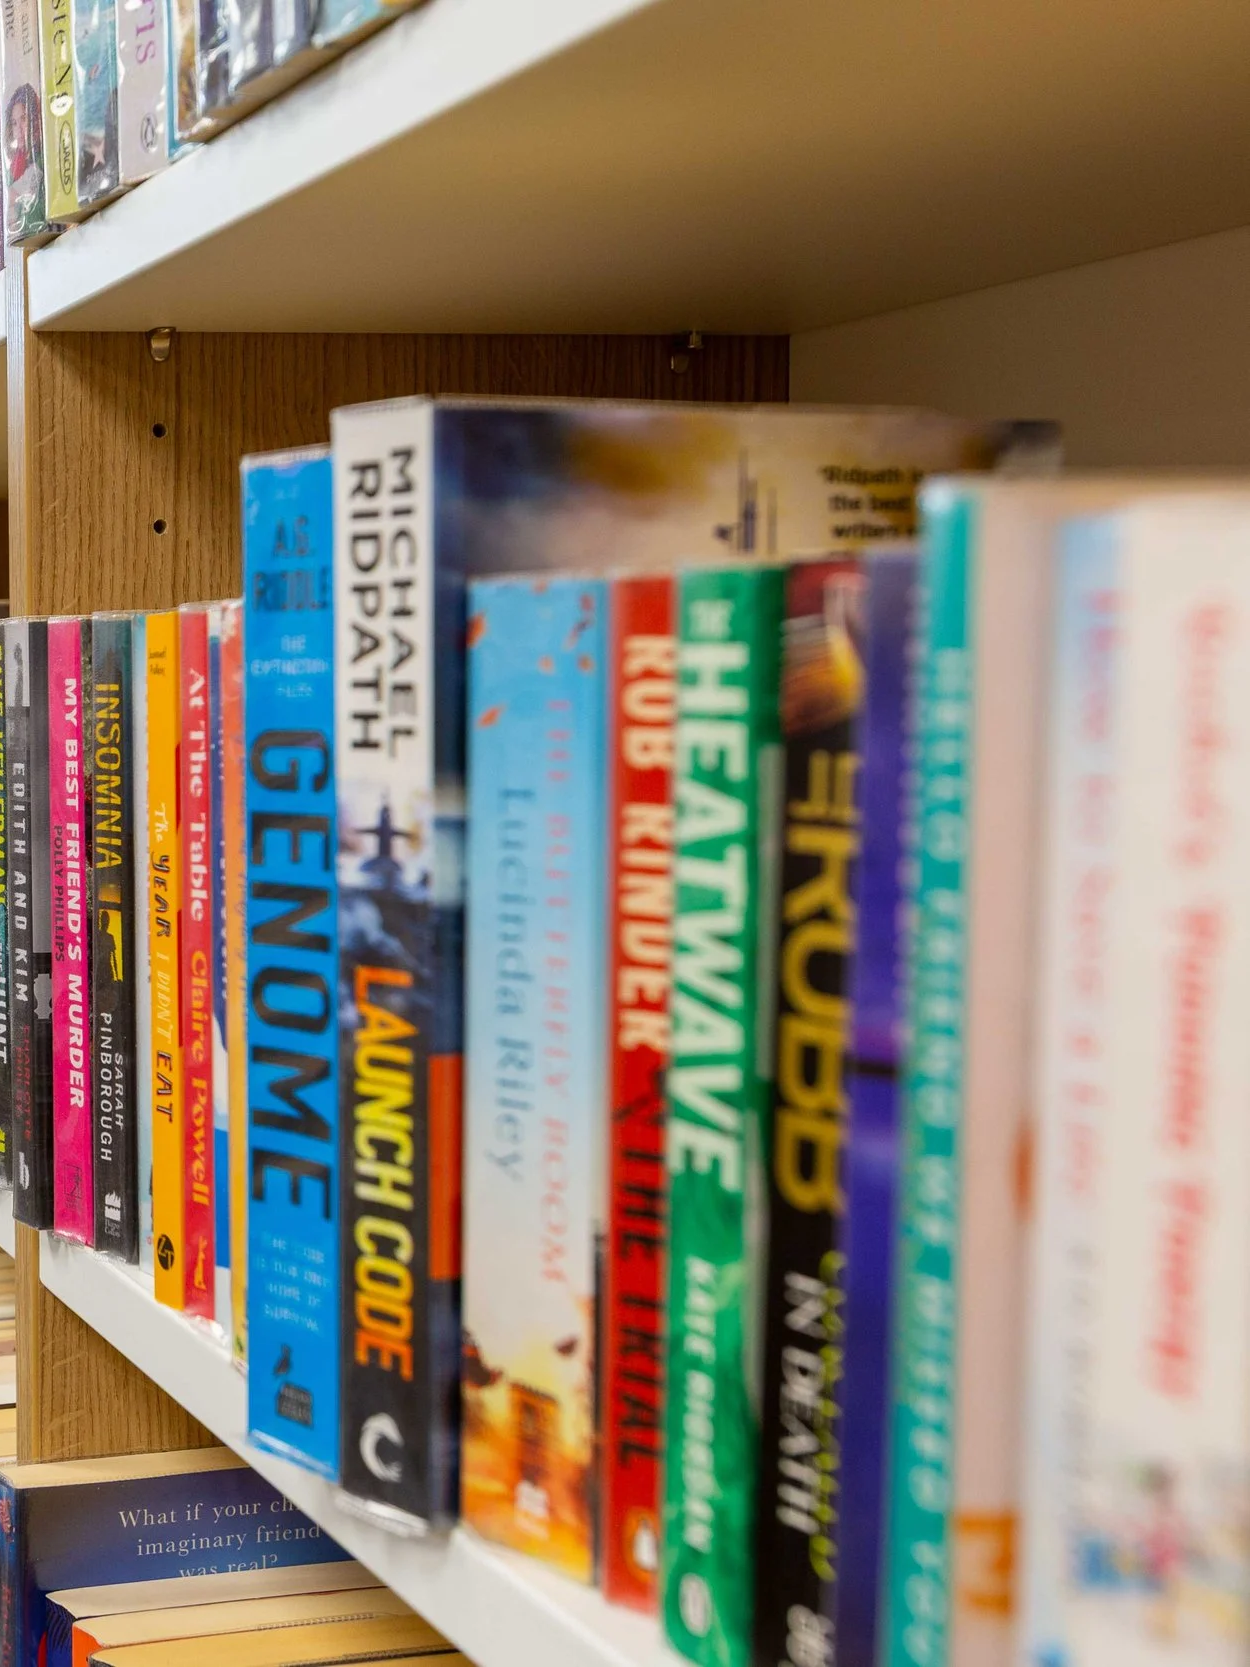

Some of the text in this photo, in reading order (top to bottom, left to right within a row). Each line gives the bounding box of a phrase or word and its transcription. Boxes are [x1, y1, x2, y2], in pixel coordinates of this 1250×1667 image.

[349, 460, 384, 752] RIDPATH
[388, 446, 417, 758] MICHAEL
[621, 634, 677, 771] ROB
[12, 762, 29, 1002] EDITH AND KIM
[94, 683, 123, 869] INSOMNIA
[154, 803, 170, 842] The
[189, 668, 209, 922] At The Table
[53, 825, 65, 963] POLLY PHILLIPS
[64, 678, 85, 1109] MY BEST FRIEND'S MURDER
[251, 729, 332, 1219] GENOME
[483, 788, 535, 1183] Lucinda Riley
[667, 642, 749, 1193] HEATWAVE
[100, 1012, 113, 1162] PINBOROUGH
[114, 1052, 124, 1131] SARAH
[156, 1050, 174, 1124] EAT
[191, 950, 211, 1206] Claire Powell
[354, 965, 418, 1382] LAUNCH CODE
[118, 1496, 301, 1529] What if your ch
[137, 1524, 321, 1557] imaginary friend
[179, 1553, 278, 1577] was real?
